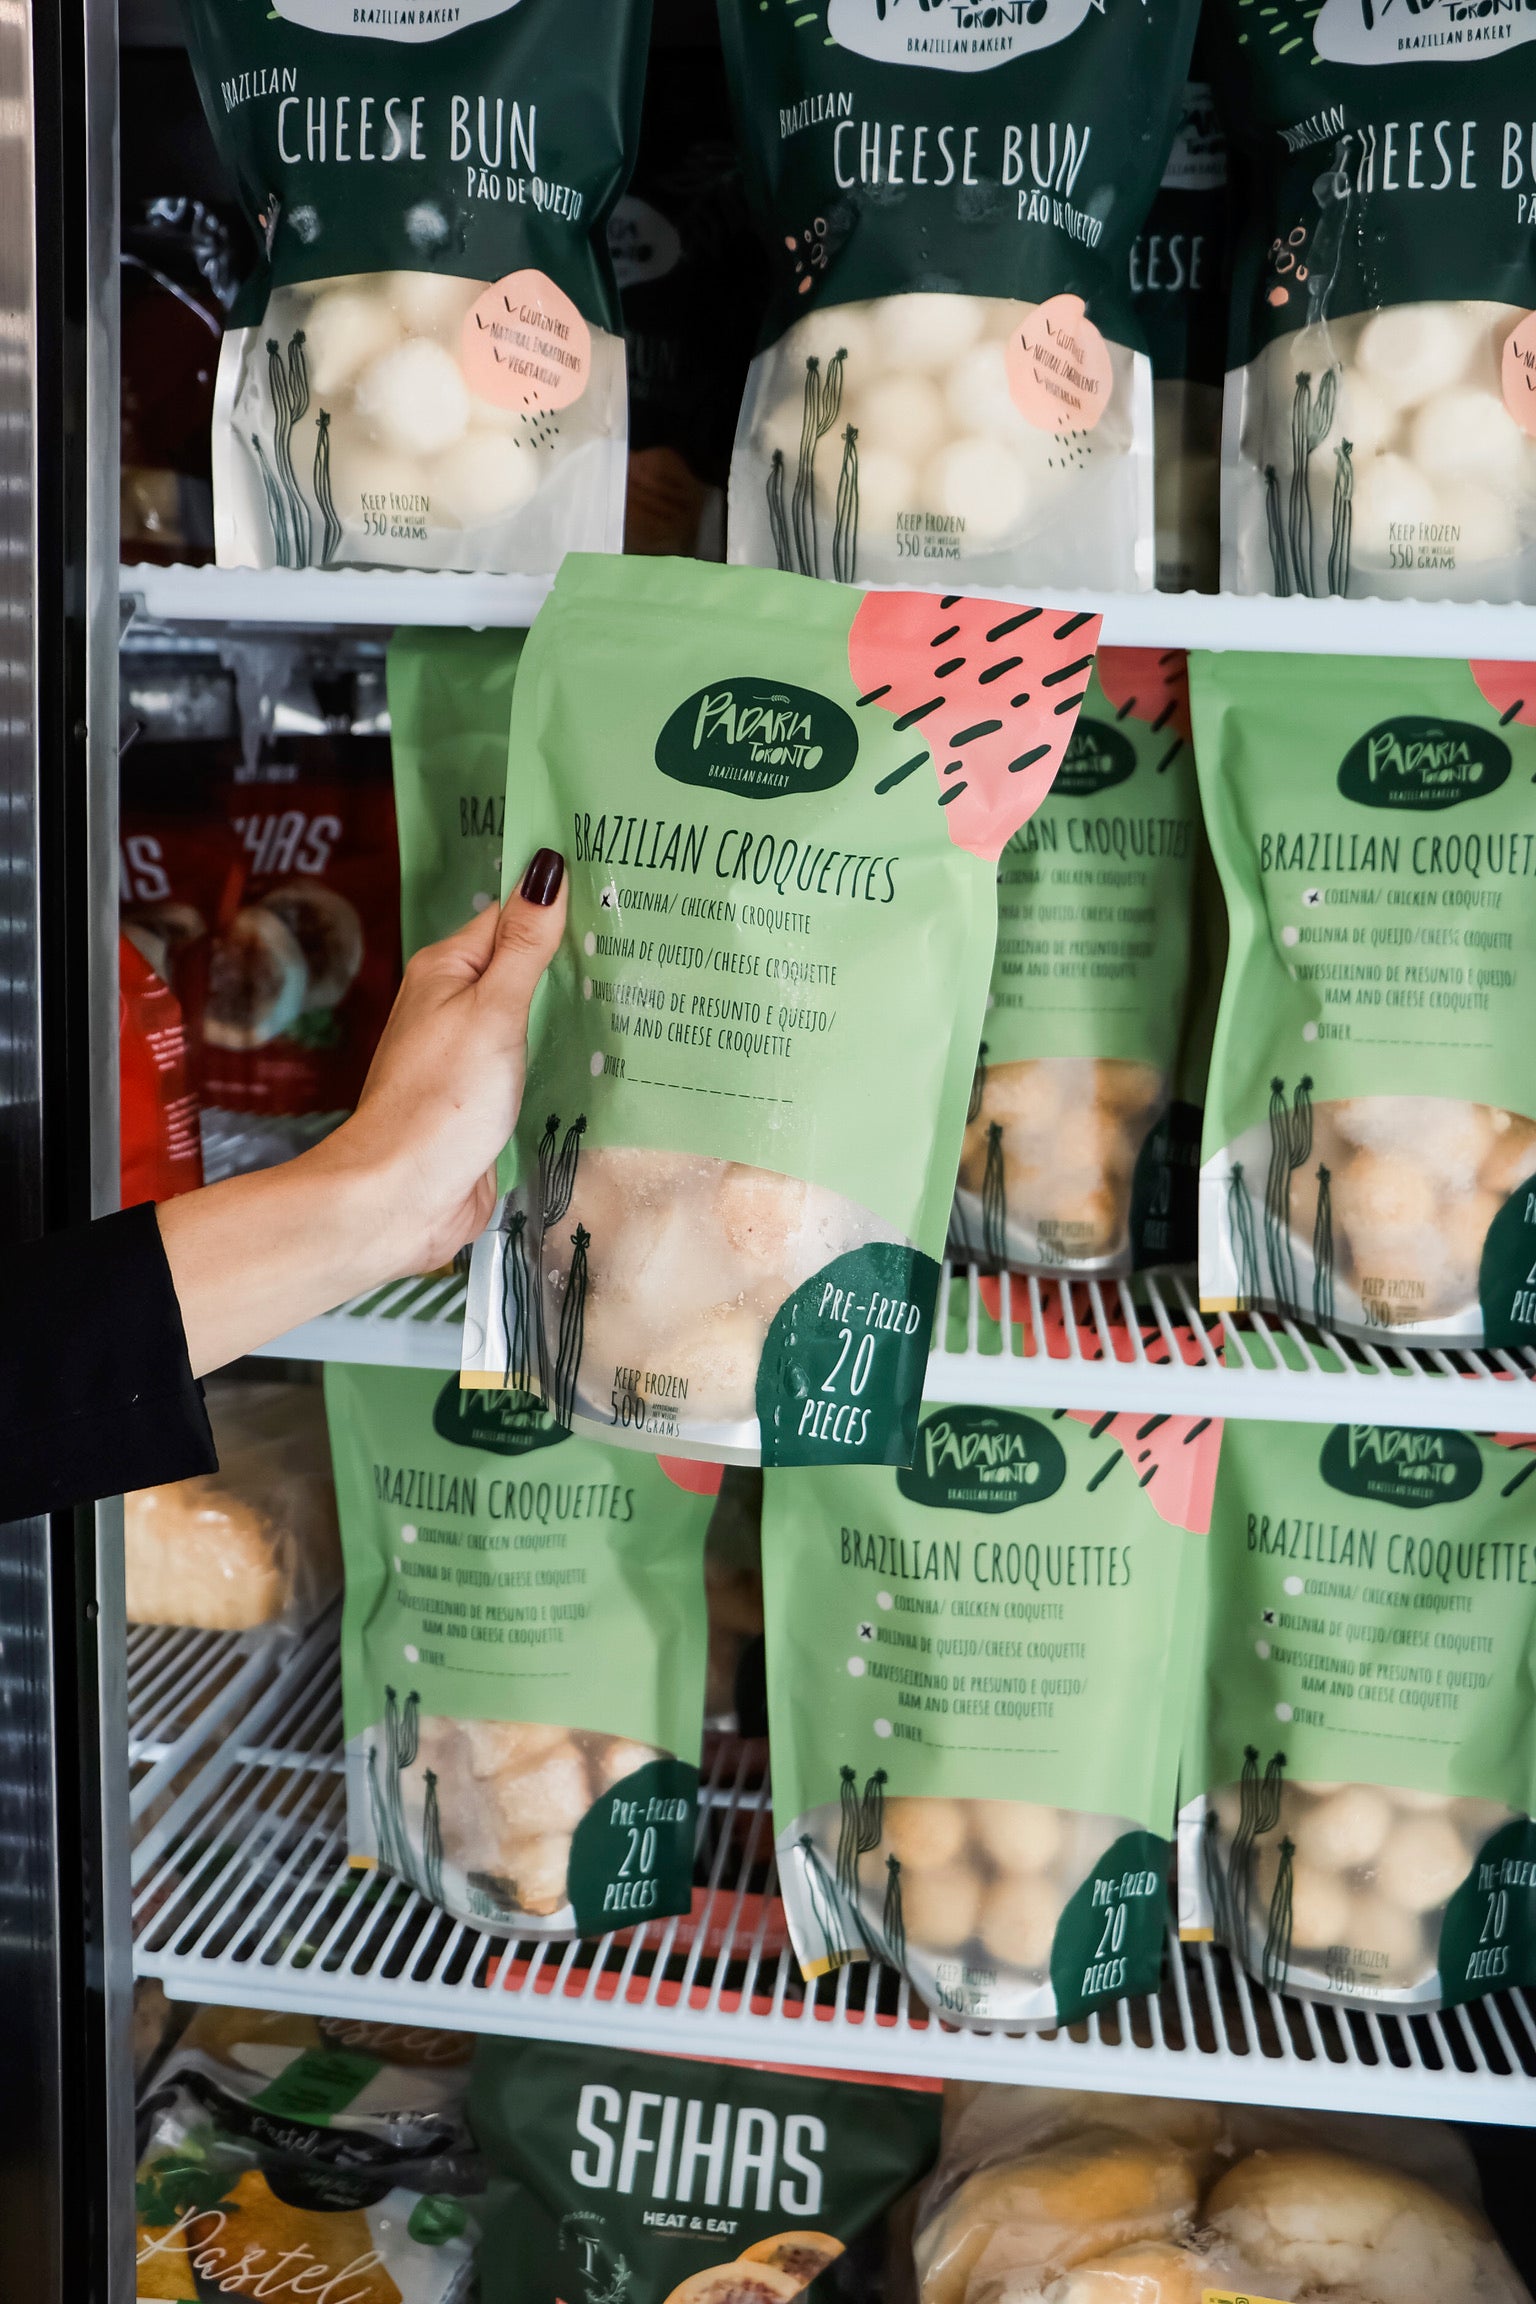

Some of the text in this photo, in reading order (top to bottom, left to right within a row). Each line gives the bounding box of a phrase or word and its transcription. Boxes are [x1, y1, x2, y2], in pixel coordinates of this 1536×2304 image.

[353, 8, 460, 25] BRAZILIAN BAKERY
[907, 36, 1013, 53] BRAZILIAN BAKERY
[1398, 24, 1512, 50] BRAZILIAN BAKERY
[221, 67, 297, 113] BRAZILIAN
[779, 91, 852, 139] BRAZILIAN
[278, 95, 536, 173] CHEESE BUN
[833, 120, 1090, 198] CHEESE BUN
[467, 165, 500, 200] PÃO
[506, 176, 526, 204] DE
[1017, 189, 1049, 223] PÃO
[1052, 198, 1064, 229] DE
[360, 492, 429, 512] KEEP FROZEN
[363, 512, 387, 536] 550
[390, 525, 428, 540] GRAMS
[896, 512, 965, 532] KEEP FROZEN
[1389, 522, 1461, 541] KEEP FROZEN
[896, 533, 919, 557] 550
[1389, 544, 1413, 568] 550
[1417, 556, 1456, 569] GRAMS
[692, 691, 811, 750] PADARIA
[749, 741, 824, 771] TORONTO
[1368, 732, 1470, 783] PADARIA
[708, 764, 790, 788] BRAZILIAN BAKERY
[574, 812, 899, 903] BRAZILIAN CROQUETTES
[1260, 832, 1400, 873] BRAZILIAN
[618, 888, 811, 934] COXINHA/ CHICKEN CROQUETTE
[1386, 889, 1437, 906] CHICKEN
[1441, 890, 1502, 910] CROQUETTE
[1352, 927, 1366, 944] DE
[639, 940, 654, 961] DE
[766, 957, 837, 986] CROQUETTE
[1386, 965, 1400, 982] DE
[1405, 966, 1463, 984] PRESUNTO
[670, 992, 684, 1014] DE
[691, 995, 760, 1025] PRESUNTO
[766, 1006, 773, 1026] E
[1325, 988, 1351, 1004] HAM
[1355, 988, 1381, 1005] AND
[1385, 989, 1425, 1007] CHEESE
[611, 1012, 793, 1058] HAM AND CHEESE CROQUETTE
[603, 1053, 626, 1079] OTHER
[817, 1282, 920, 1335] PRE-FRIED
[1361, 1298, 1391, 1328] 500
[821, 1328, 875, 1396] 20
[614, 1365, 689, 1400] KEEP FROZEN
[610, 1391, 680, 1437] 500 GRAMS
[797, 1398, 872, 1446] PIECES
[925, 1422, 1026, 1478] PADARIA
[373, 1464, 634, 1524] BRAZILIAN CROQUETTES
[840, 1526, 1131, 1591] BRAZILIAN CROQUETTES
[1247, 1512, 1376, 1570] BRAZILIAN
[951, 1597, 1064, 1623] CHICKEN CROQUETTE
[1362, 1587, 1408, 1607] CHICKEN
[1329, 1619, 1343, 1637] DE
[920, 1635, 932, 1654] DE
[1026, 1641, 1086, 1663] CROQUETTE
[953, 1673, 1036, 1694] DE PRESUNTO E
[1359, 1661, 1372, 1679] DE
[1376, 1661, 1432, 1685] PRESUNTO
[898, 1691, 1054, 1720] HAM AND CHEESE CROQUETTE
[1330, 1679, 1354, 1699] AND
[1358, 1683, 1395, 1704] CHEESE
[610, 1797, 689, 1826] PRE-FRIED
[617, 1826, 657, 1878] 20
[602, 1878, 658, 1912] PIECES
[1092, 1871, 1157, 1907] PRE-FRIED
[1095, 1903, 1128, 1958] 20
[1479, 1889, 1508, 1944] 20
[1081, 1957, 1128, 1997] PIECES
[1465, 1945, 1509, 1980] PIECES
[570, 2084, 827, 2216] SFIHAS
[643, 2210, 738, 2235] HEAT & EAT
[136, 2205, 386, 2304] Pastel
